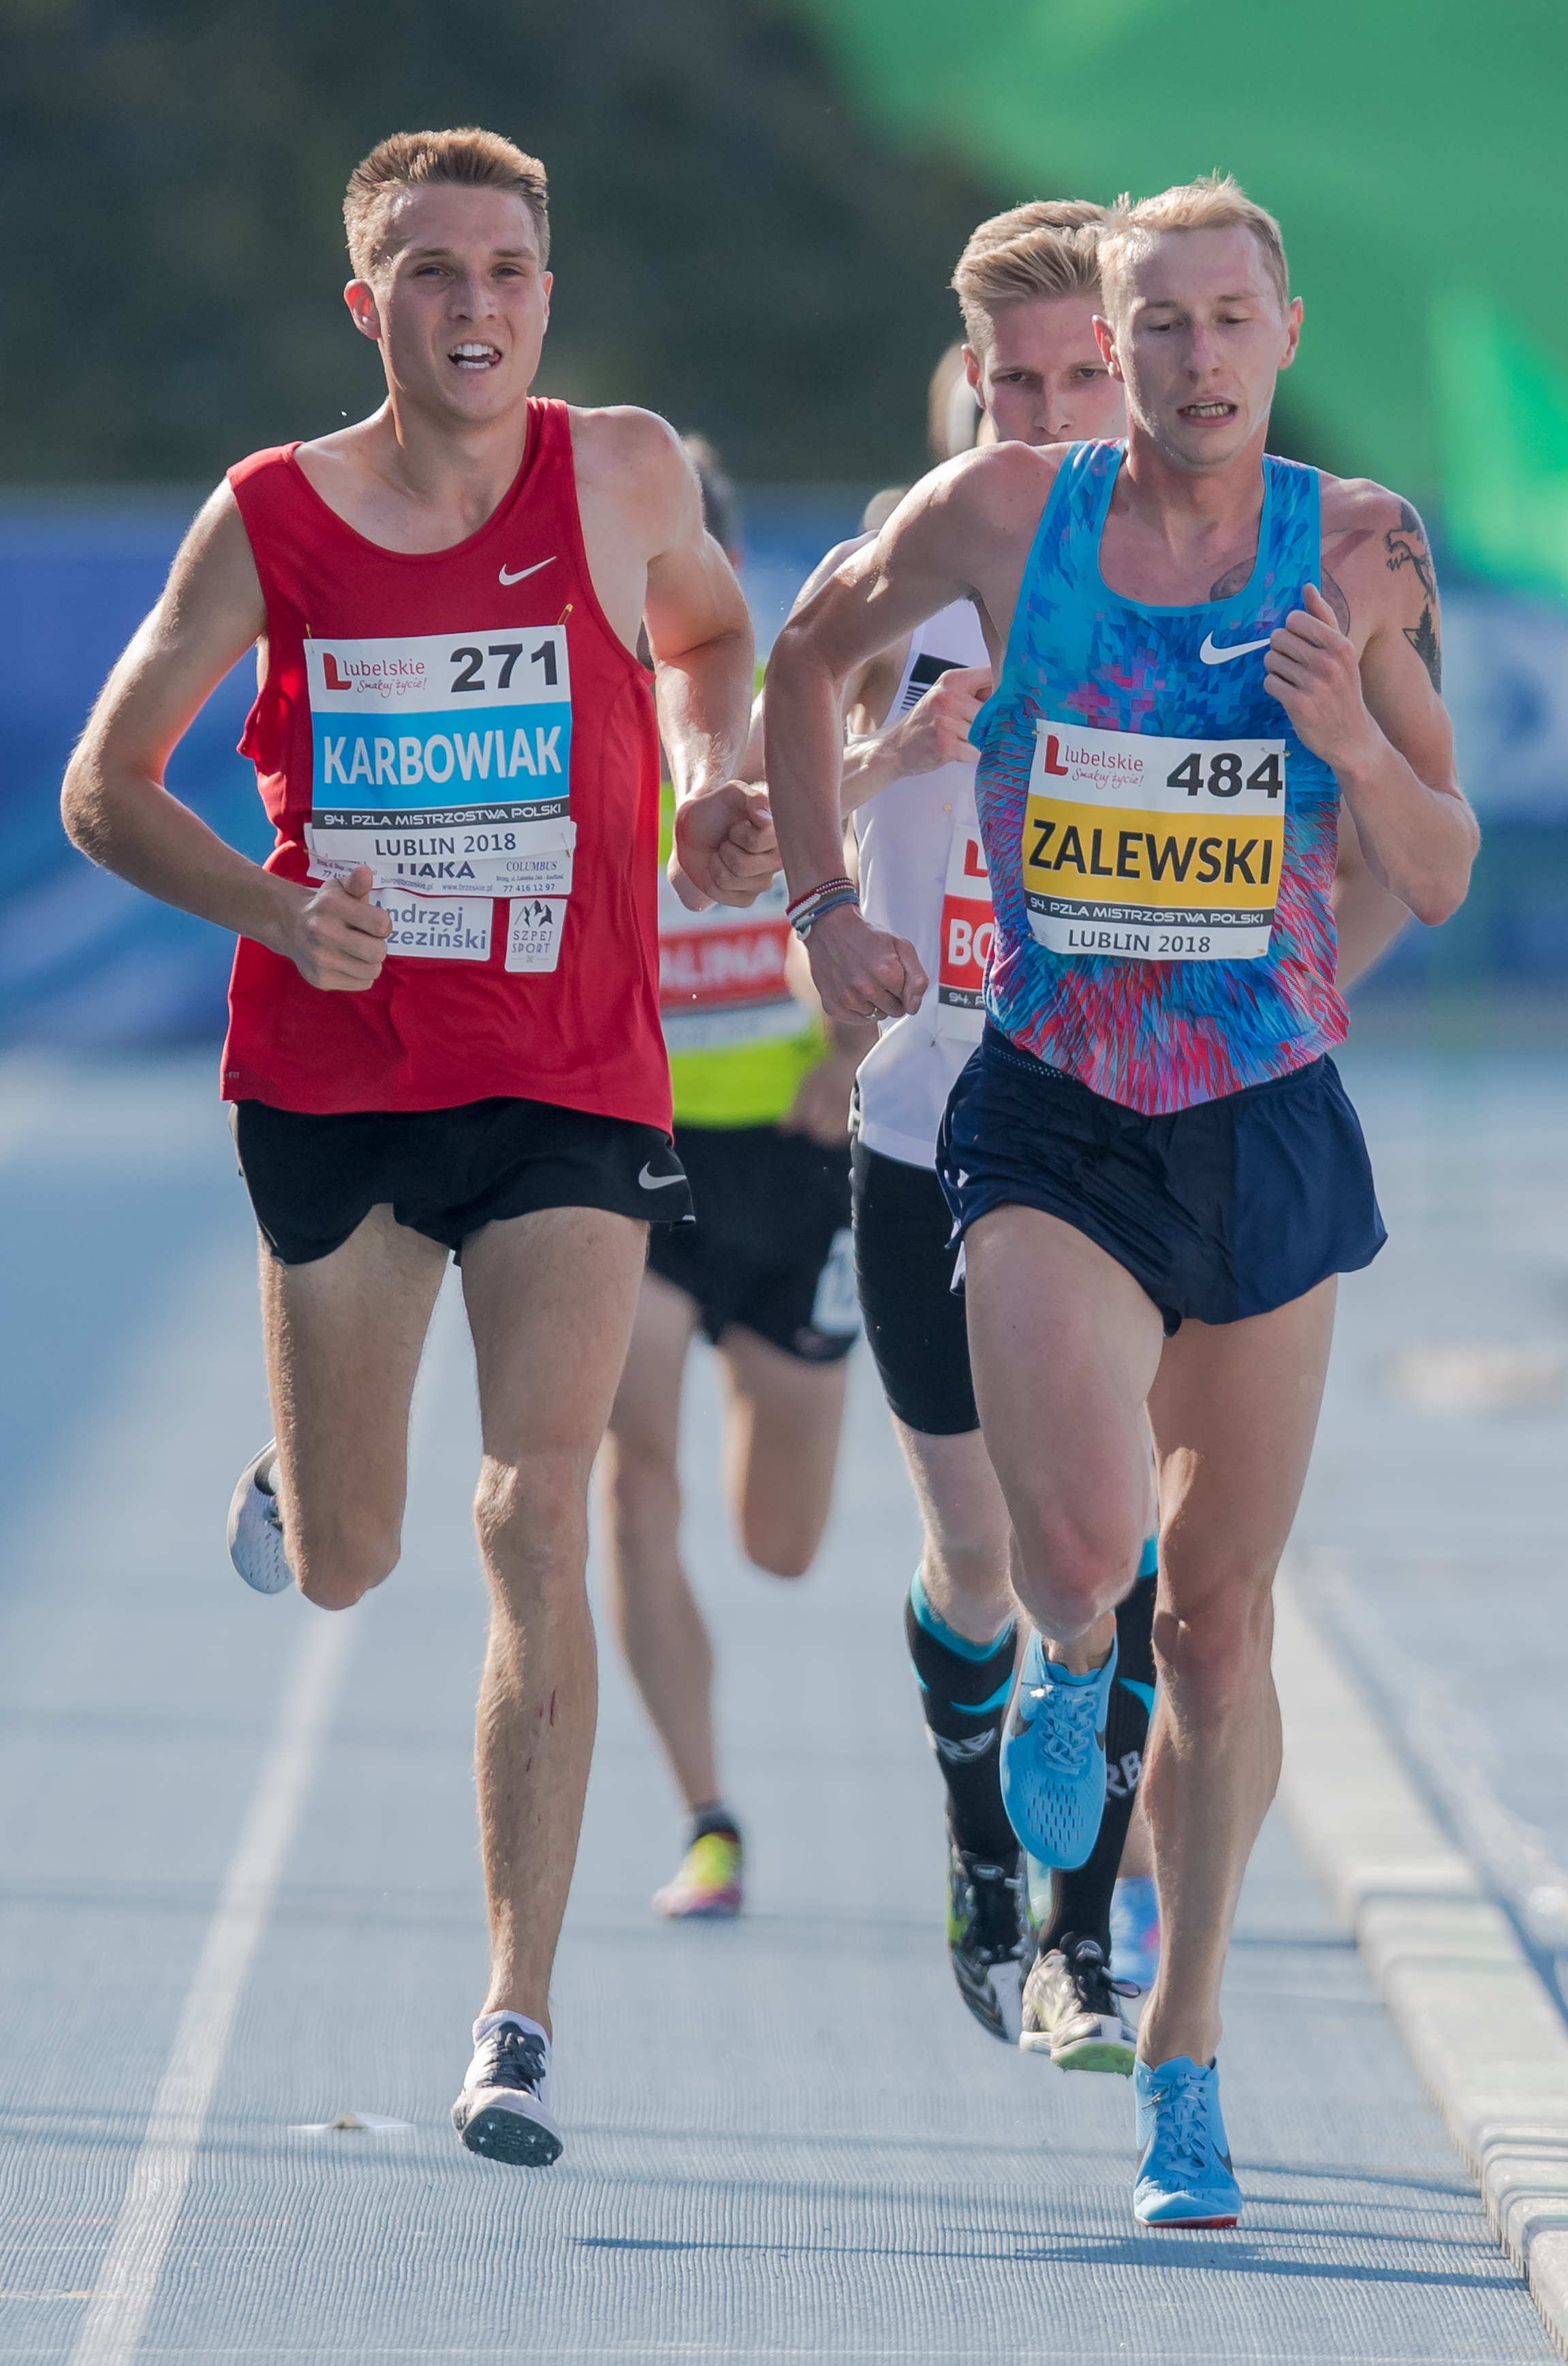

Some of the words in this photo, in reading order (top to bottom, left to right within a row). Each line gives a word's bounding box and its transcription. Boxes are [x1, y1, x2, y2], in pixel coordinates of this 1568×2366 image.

[450, 640, 559, 693] 271
[356, 679, 392, 698] Smakuj
[324, 726, 562, 785] KARBOWIAK
[1071, 766, 1109, 790] Smakuj
[1165, 752, 1283, 798] 484
[324, 813, 348, 826] 94.
[351, 813, 392, 826] PZLA
[395, 807, 507, 826] MISTRZOSTWA
[511, 803, 561, 819] POLSKI
[375, 837, 455, 856] LUBLIN
[464, 832, 517, 852] 2018
[1029, 818, 1273, 885] ZALEWSKI
[506, 860, 558, 872] COLUMBUS
[1030, 896, 1047, 912] 94.
[1050, 902, 1089, 917] PZLA
[1093, 907, 1206, 924] MISTRZOSTWA
[1210, 913, 1264, 924] POLSKI
[387, 927, 487, 949] zeziński
[512, 929, 553, 941] SZPEJ
[1068, 929, 1150, 952] LUBLIN
[1158, 934, 1211, 952] 2018
[511, 942, 550, 954] SPORT
